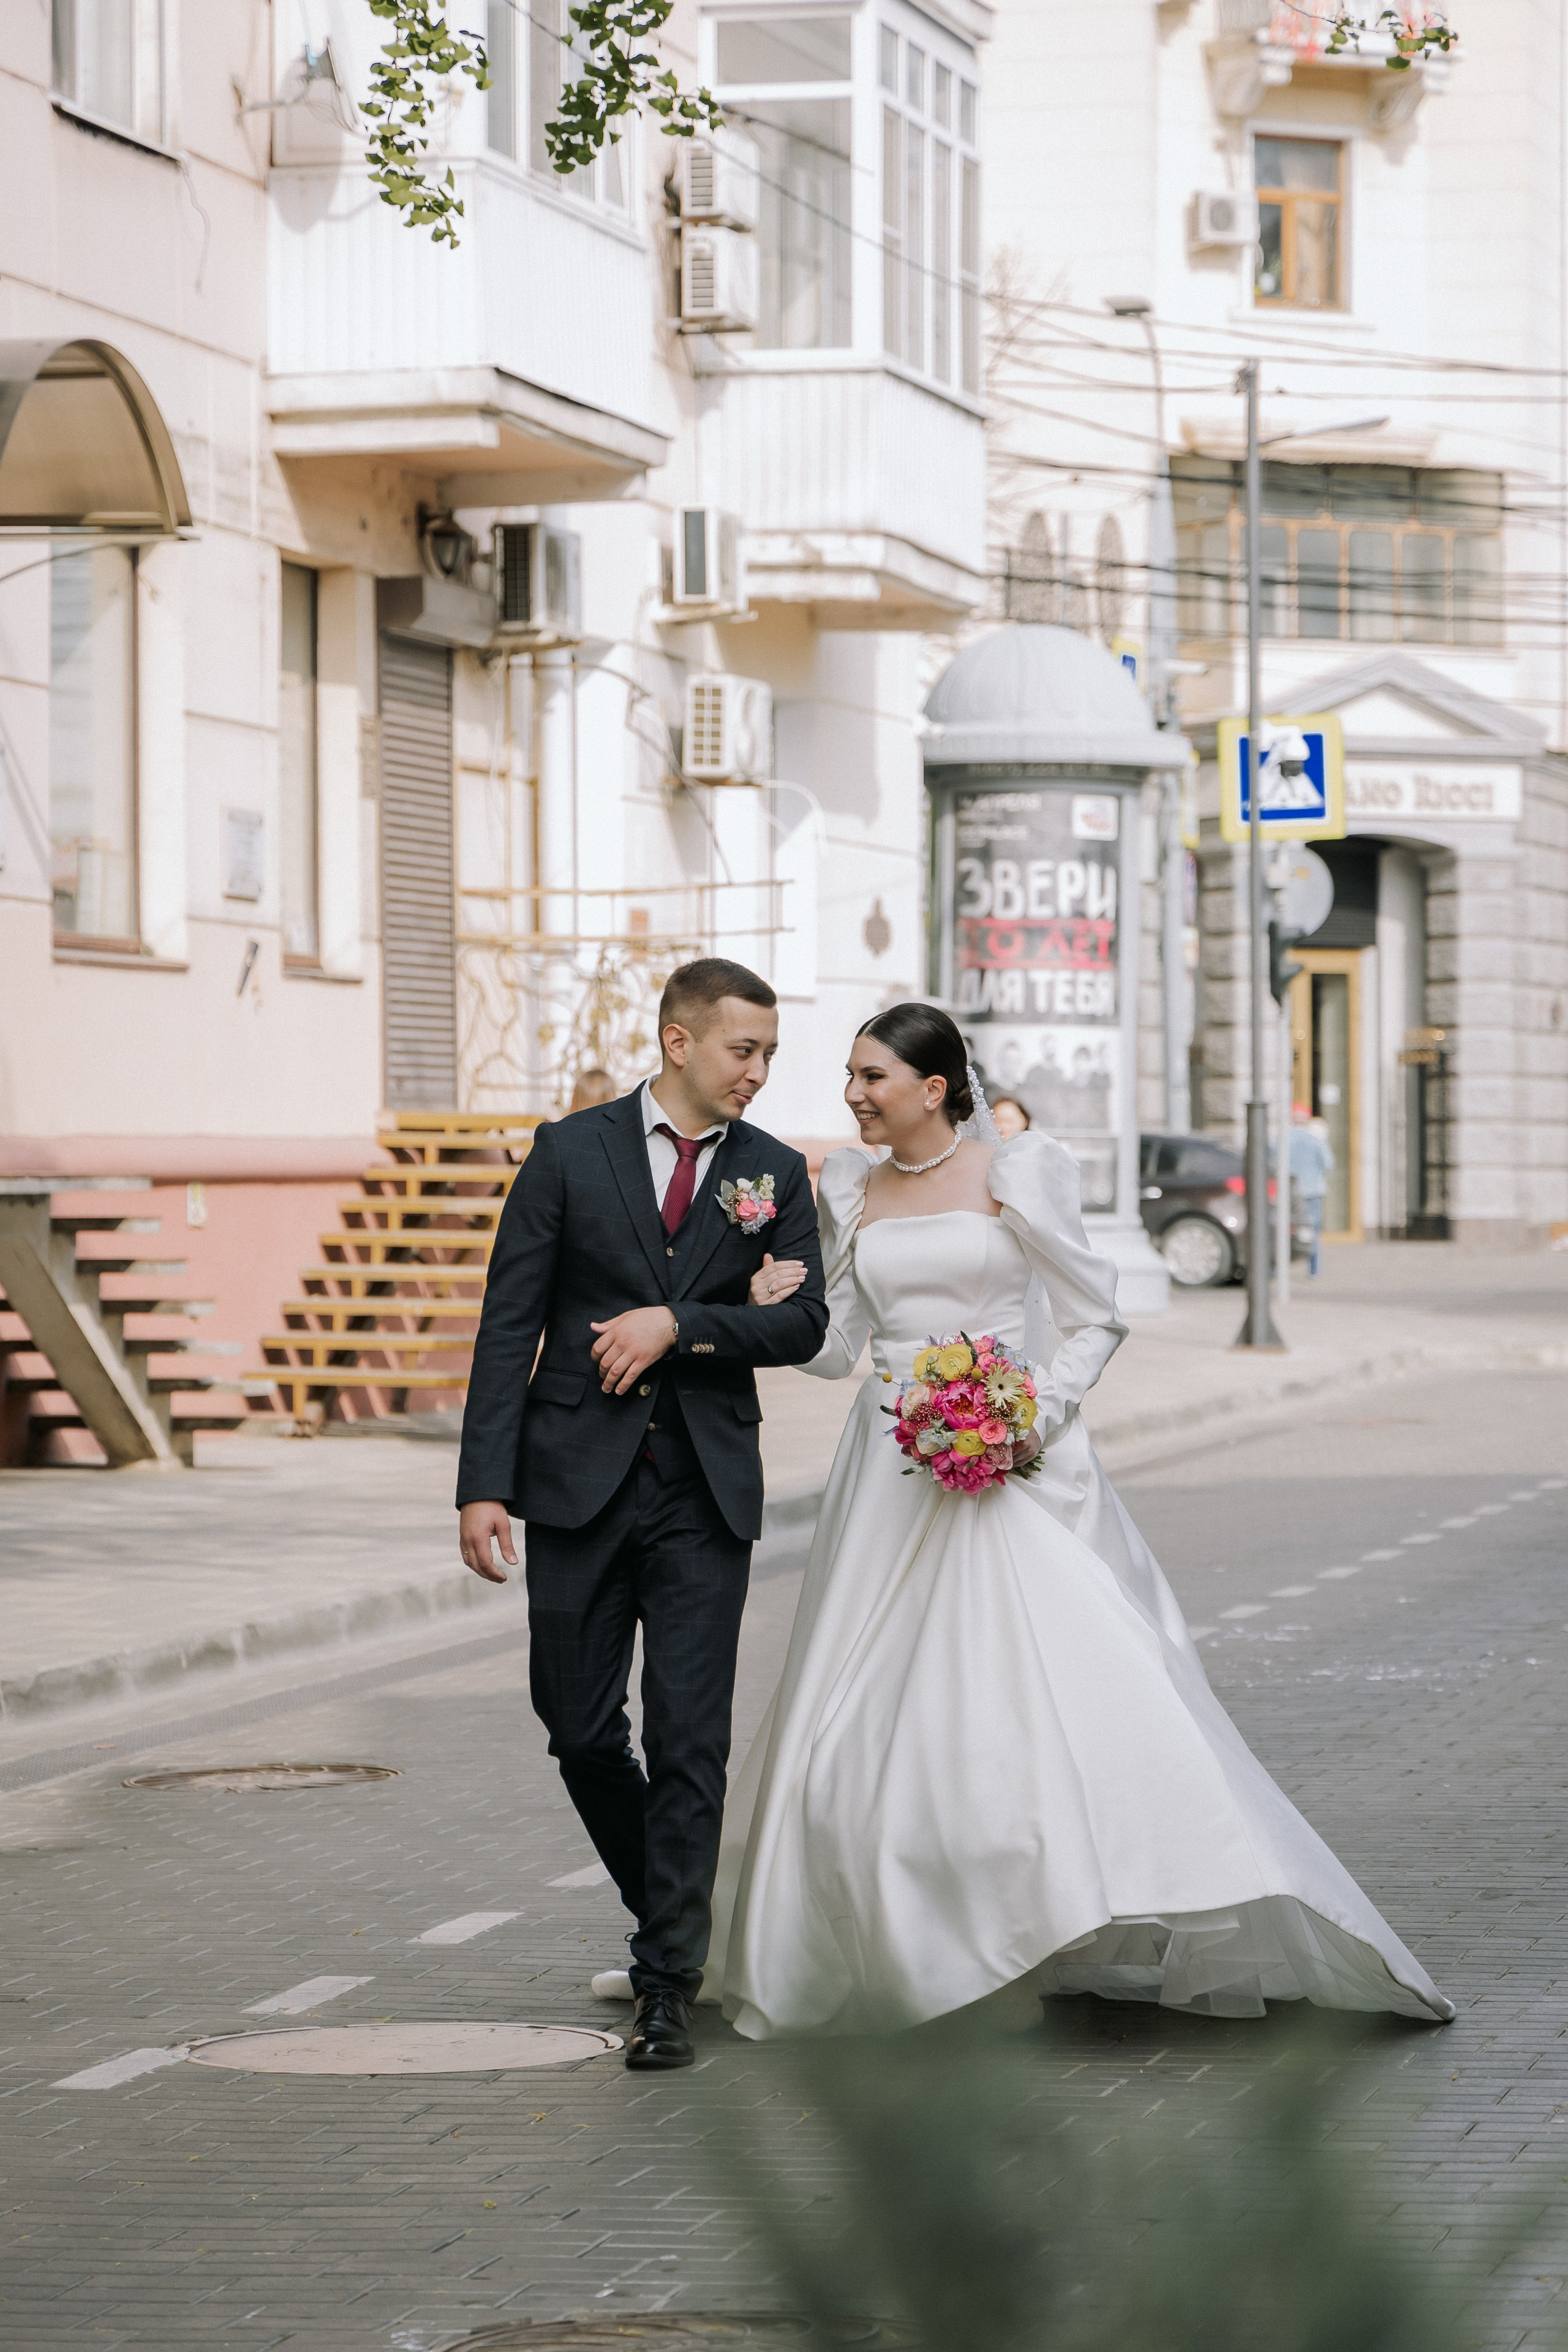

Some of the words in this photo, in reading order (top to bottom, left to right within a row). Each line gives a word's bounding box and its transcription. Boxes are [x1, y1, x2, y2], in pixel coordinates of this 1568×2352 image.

[957, 858, 1117, 920] ЗВЕРИ
[954, 969, 1025, 1014] ДЛЯ
[1028, 970, 1115, 1016] ТЕБЯ
